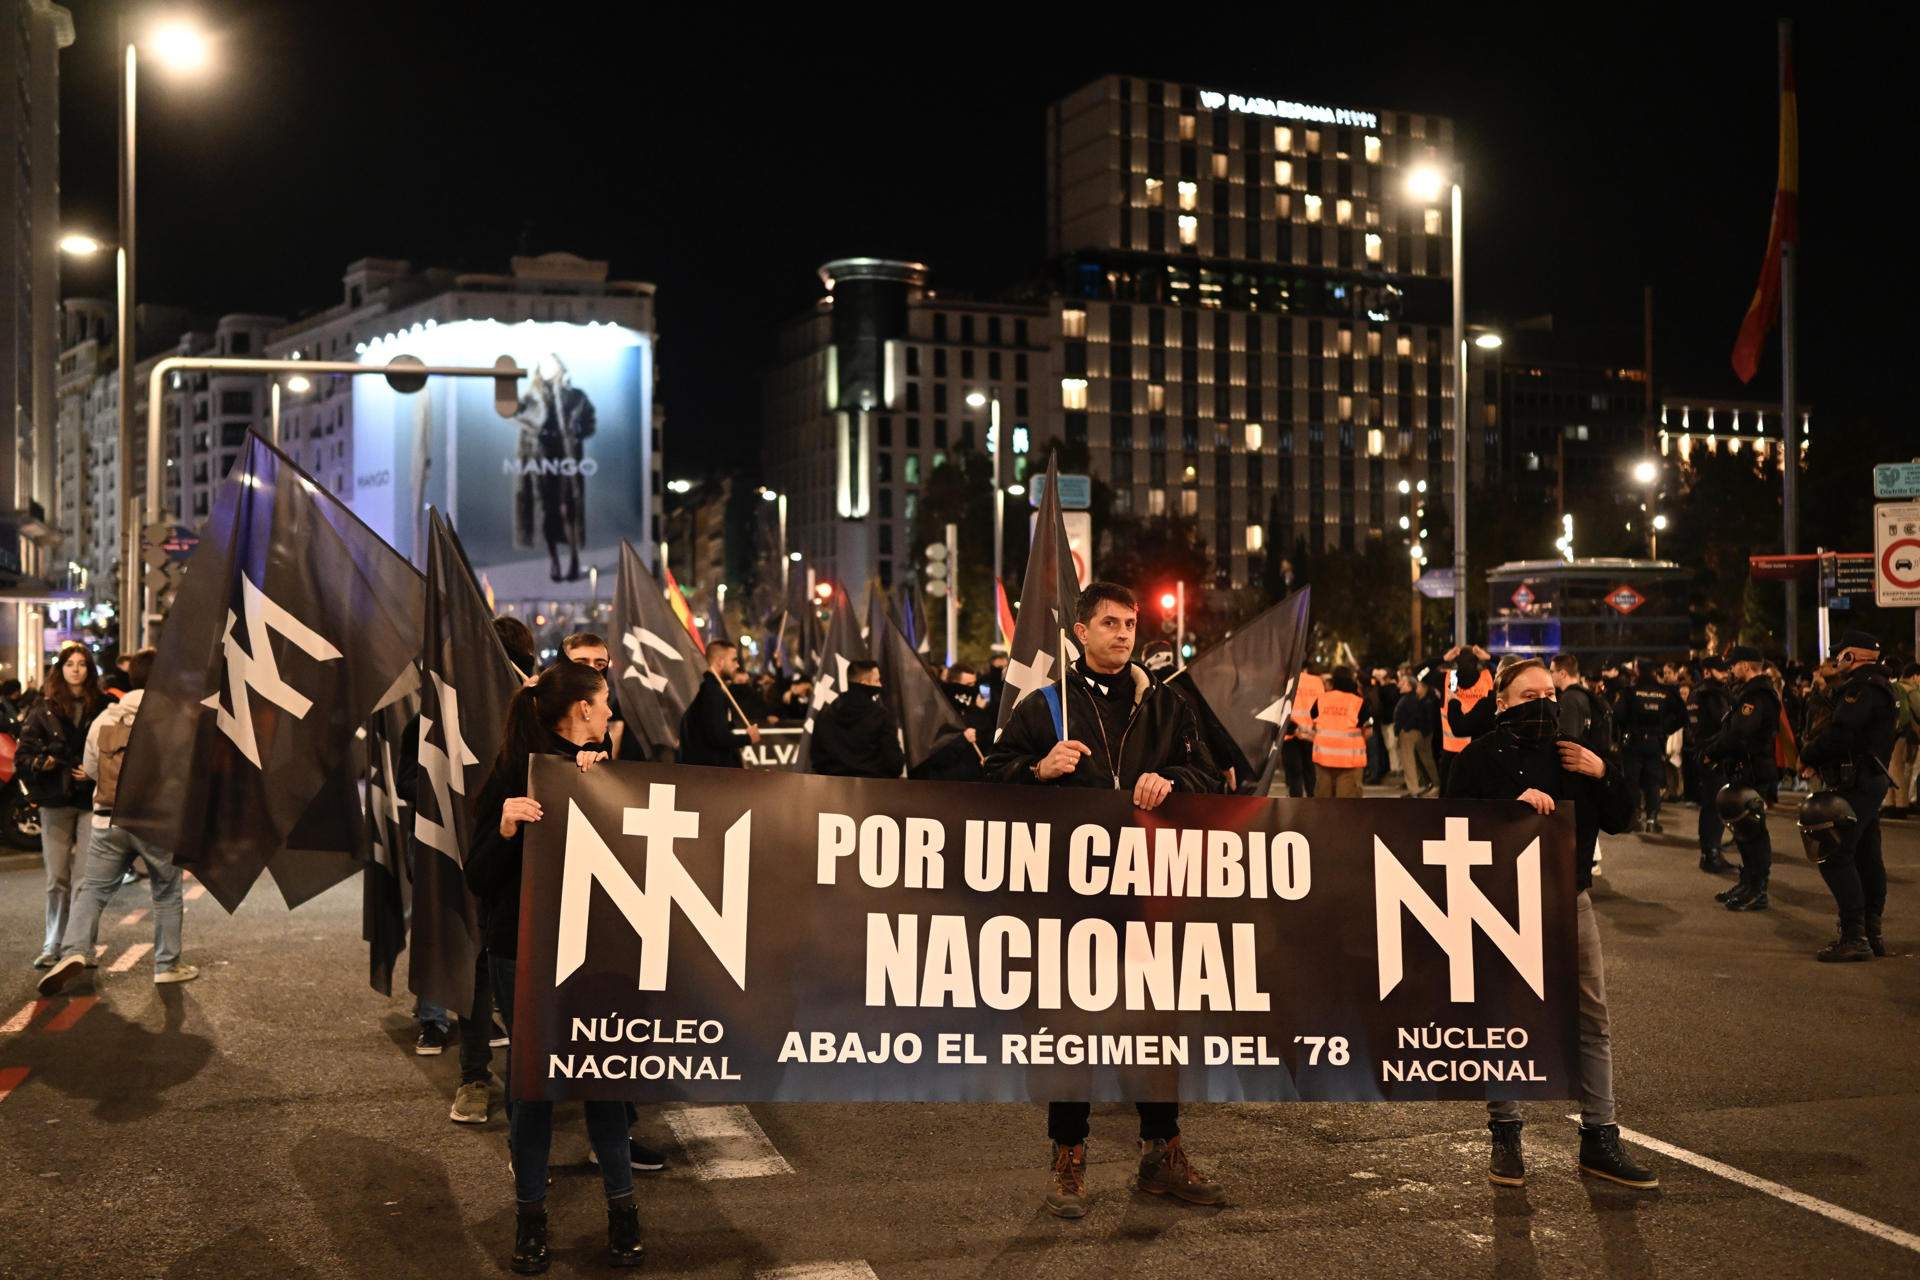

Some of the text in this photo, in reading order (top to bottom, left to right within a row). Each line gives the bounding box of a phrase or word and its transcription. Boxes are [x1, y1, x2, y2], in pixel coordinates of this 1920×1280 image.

[1228, 94, 1277, 116] PLAZA
[503, 457, 598, 477] MANGO
[816, 812, 1312, 901] POR UN CAMBIO
[865, 912, 1271, 1012] NACIONAL
[571, 1012, 724, 1044] NÚCLEO
[1397, 1022, 1530, 1050] NÚCLEO
[777, 1031, 923, 1064] ABAJO
[937, 1033, 988, 1065] EL
[1001, 1026, 1189, 1066] RÉGIMEN
[1203, 1035, 1280, 1067] DEL
[548, 1054, 742, 1081] NACIONAL
[1382, 1060, 1547, 1083] NACIONAL
